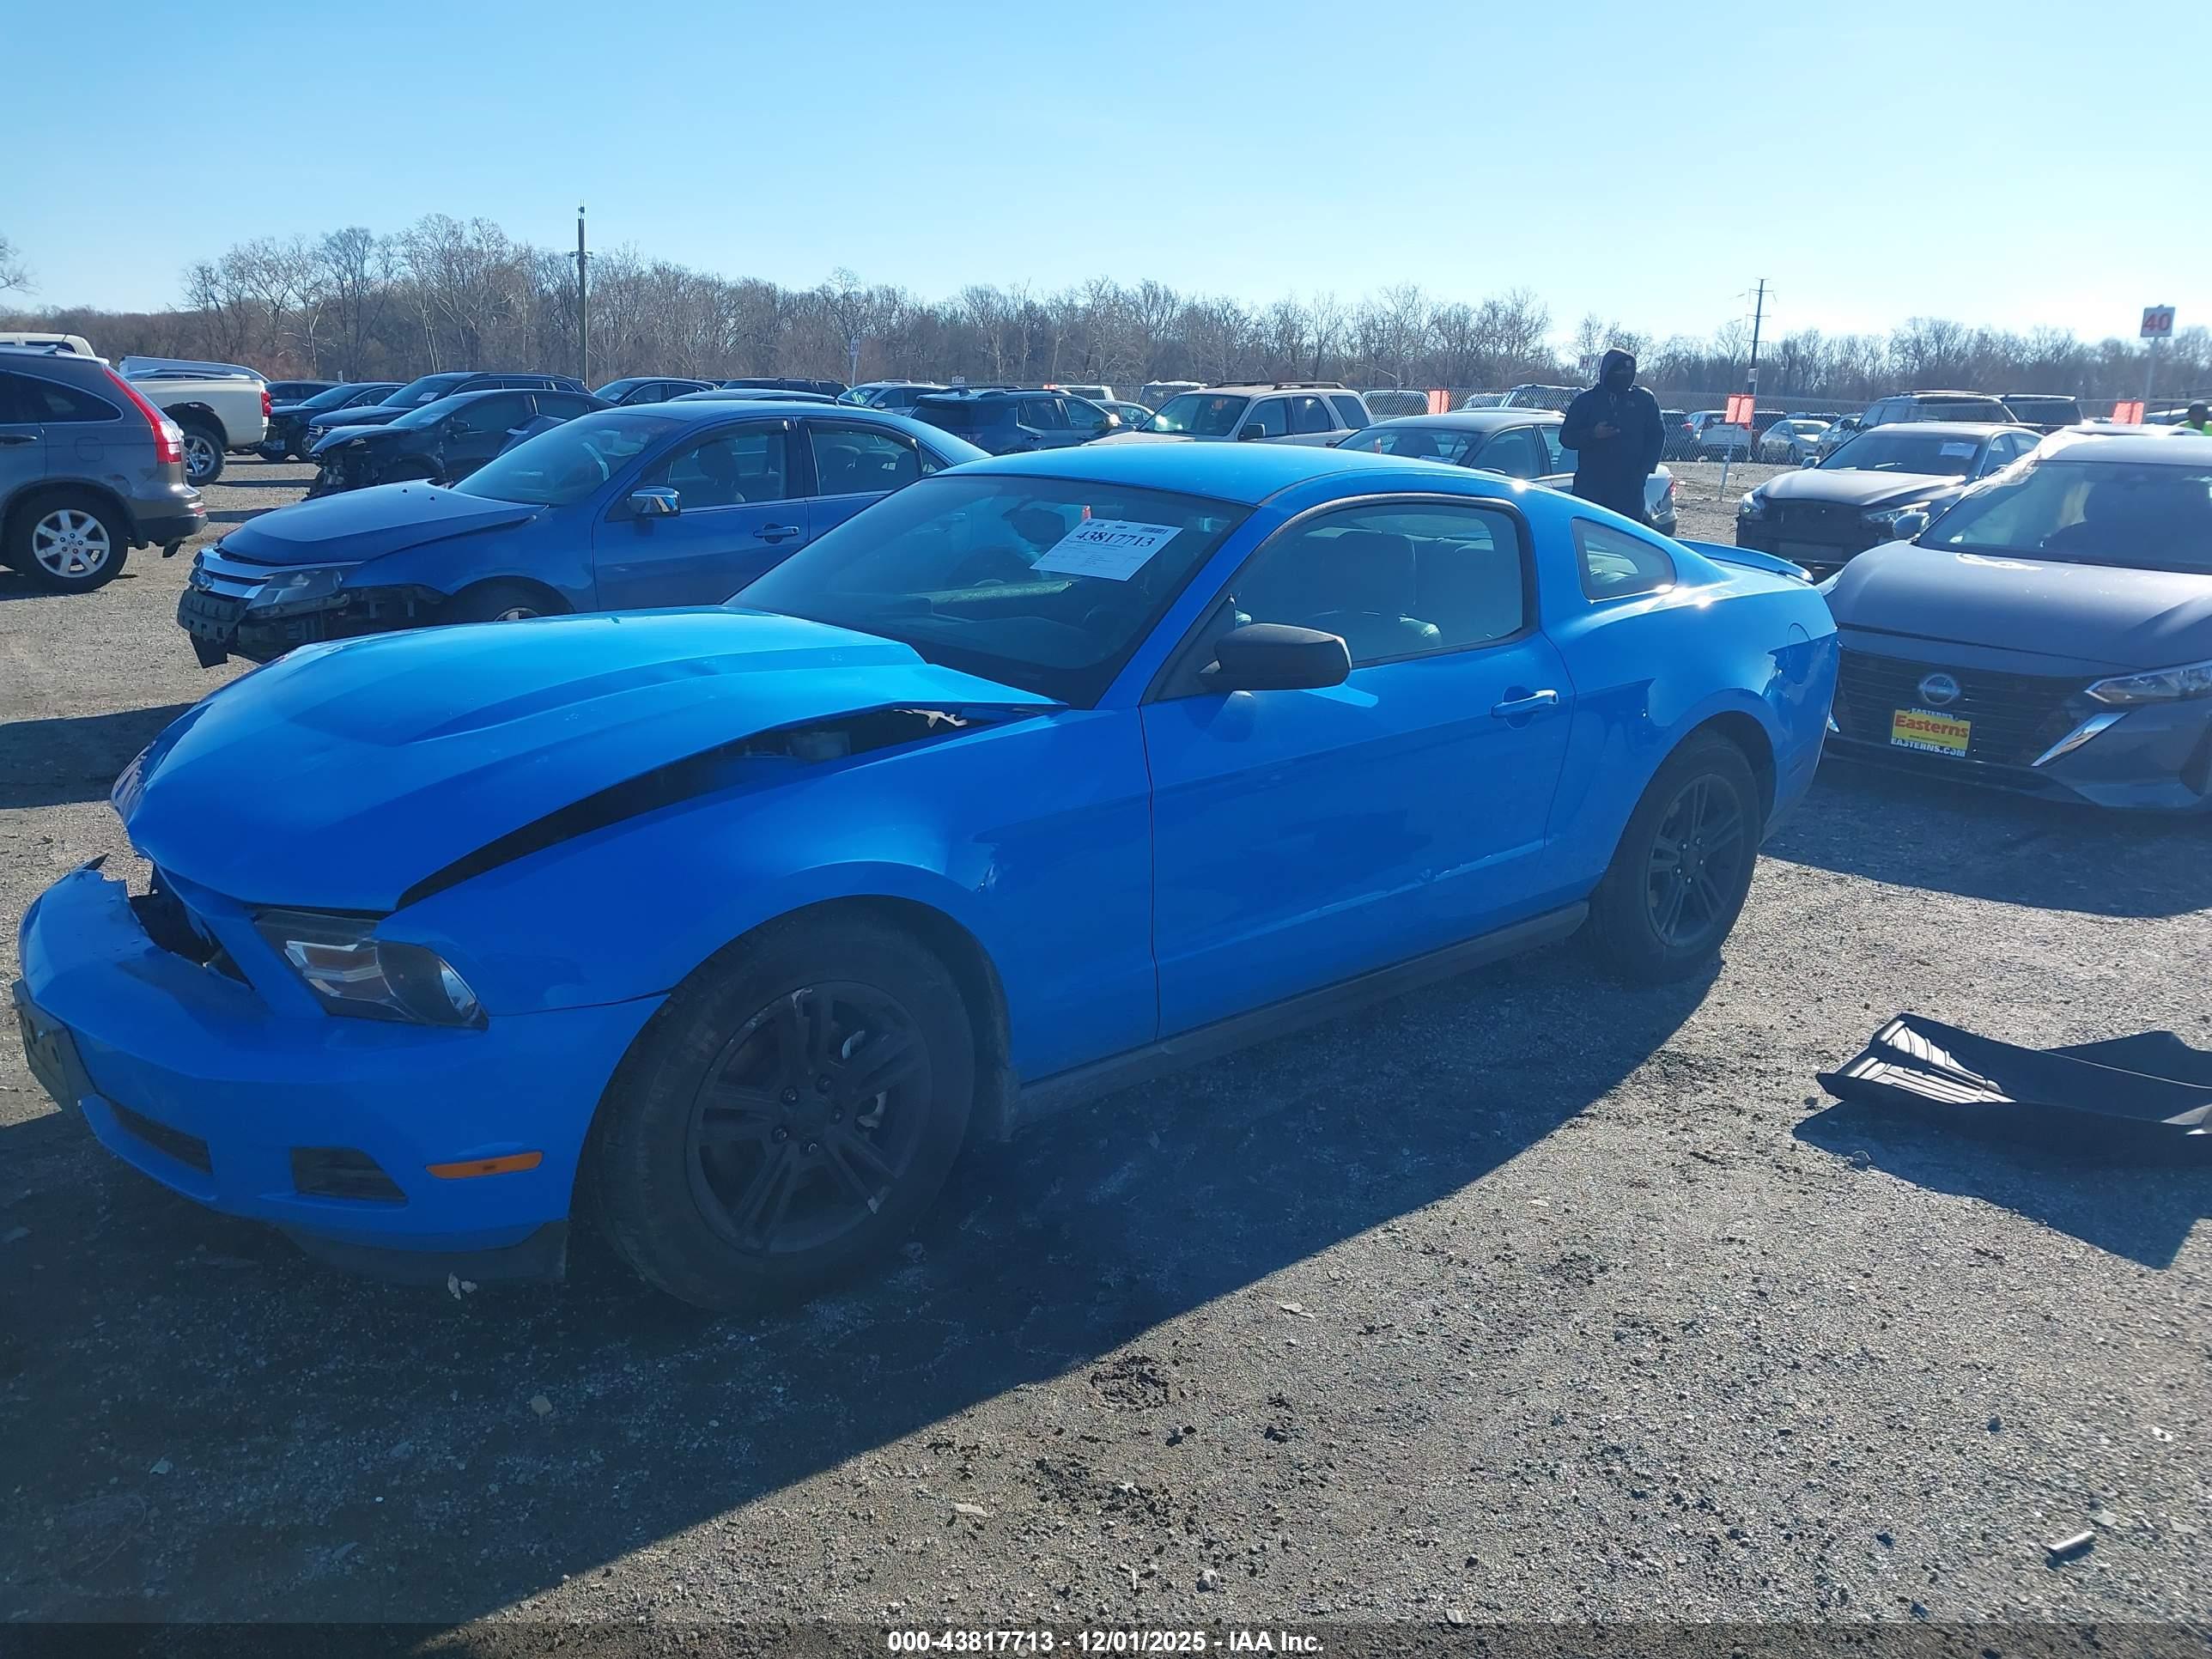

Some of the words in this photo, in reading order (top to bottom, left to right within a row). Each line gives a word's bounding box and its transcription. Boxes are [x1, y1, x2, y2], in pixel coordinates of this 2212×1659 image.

[2143, 313, 2172, 331] 40
[1075, 530, 1156, 547] 43817713
[1894, 714, 1969, 738] Easterns
[1890, 737, 1966, 757] EASTERNS.COM
